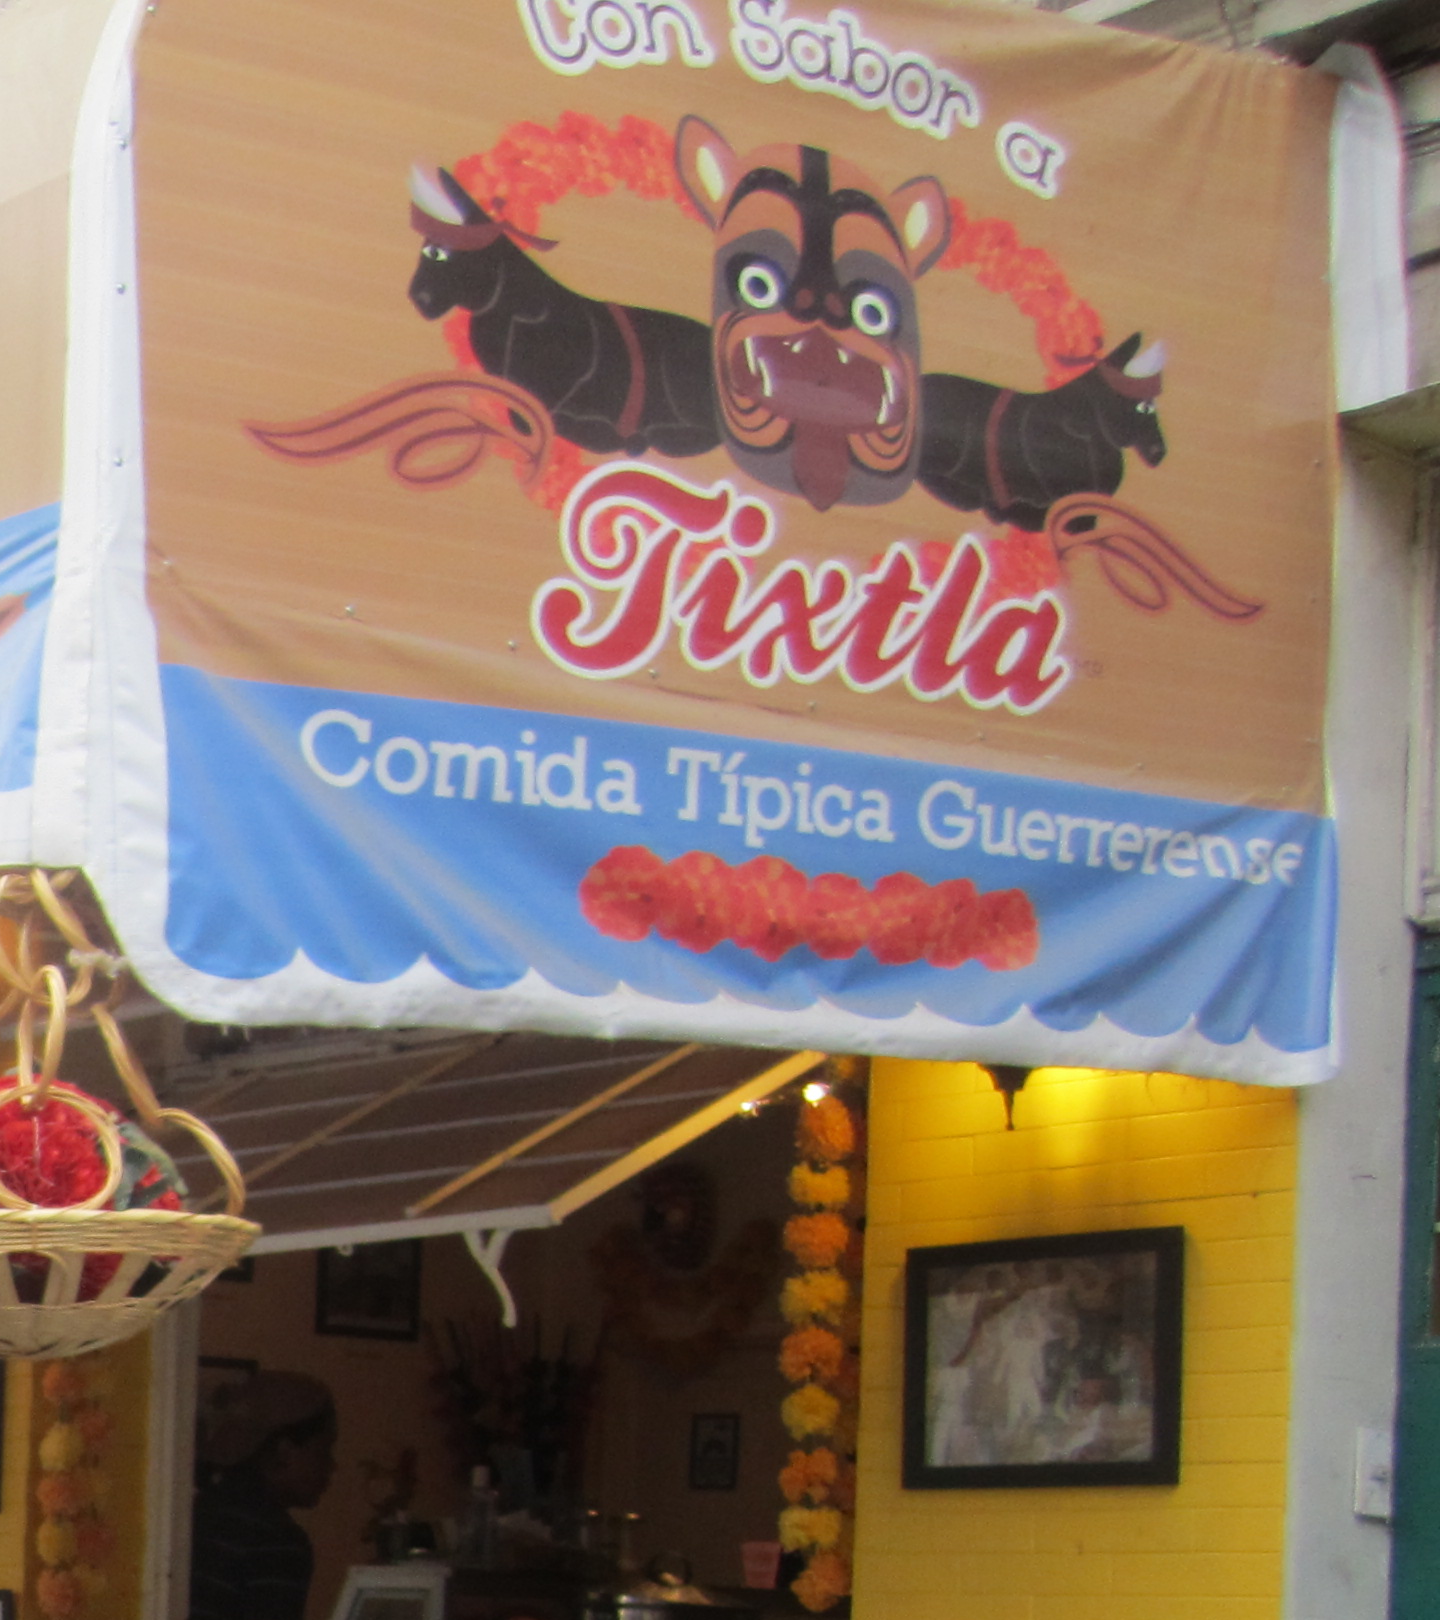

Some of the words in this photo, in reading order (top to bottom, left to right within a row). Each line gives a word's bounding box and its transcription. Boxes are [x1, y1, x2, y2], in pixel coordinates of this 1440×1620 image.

[521, 0, 712, 73] Con
[733, 0, 977, 136] Sabor
[998, 123, 1062, 196] a
[531, 460, 1069, 715] Tixtla
[299, 709, 641, 815] Comida
[666, 744, 894, 847] Típica
[917, 781, 1304, 885] Guerrerense
